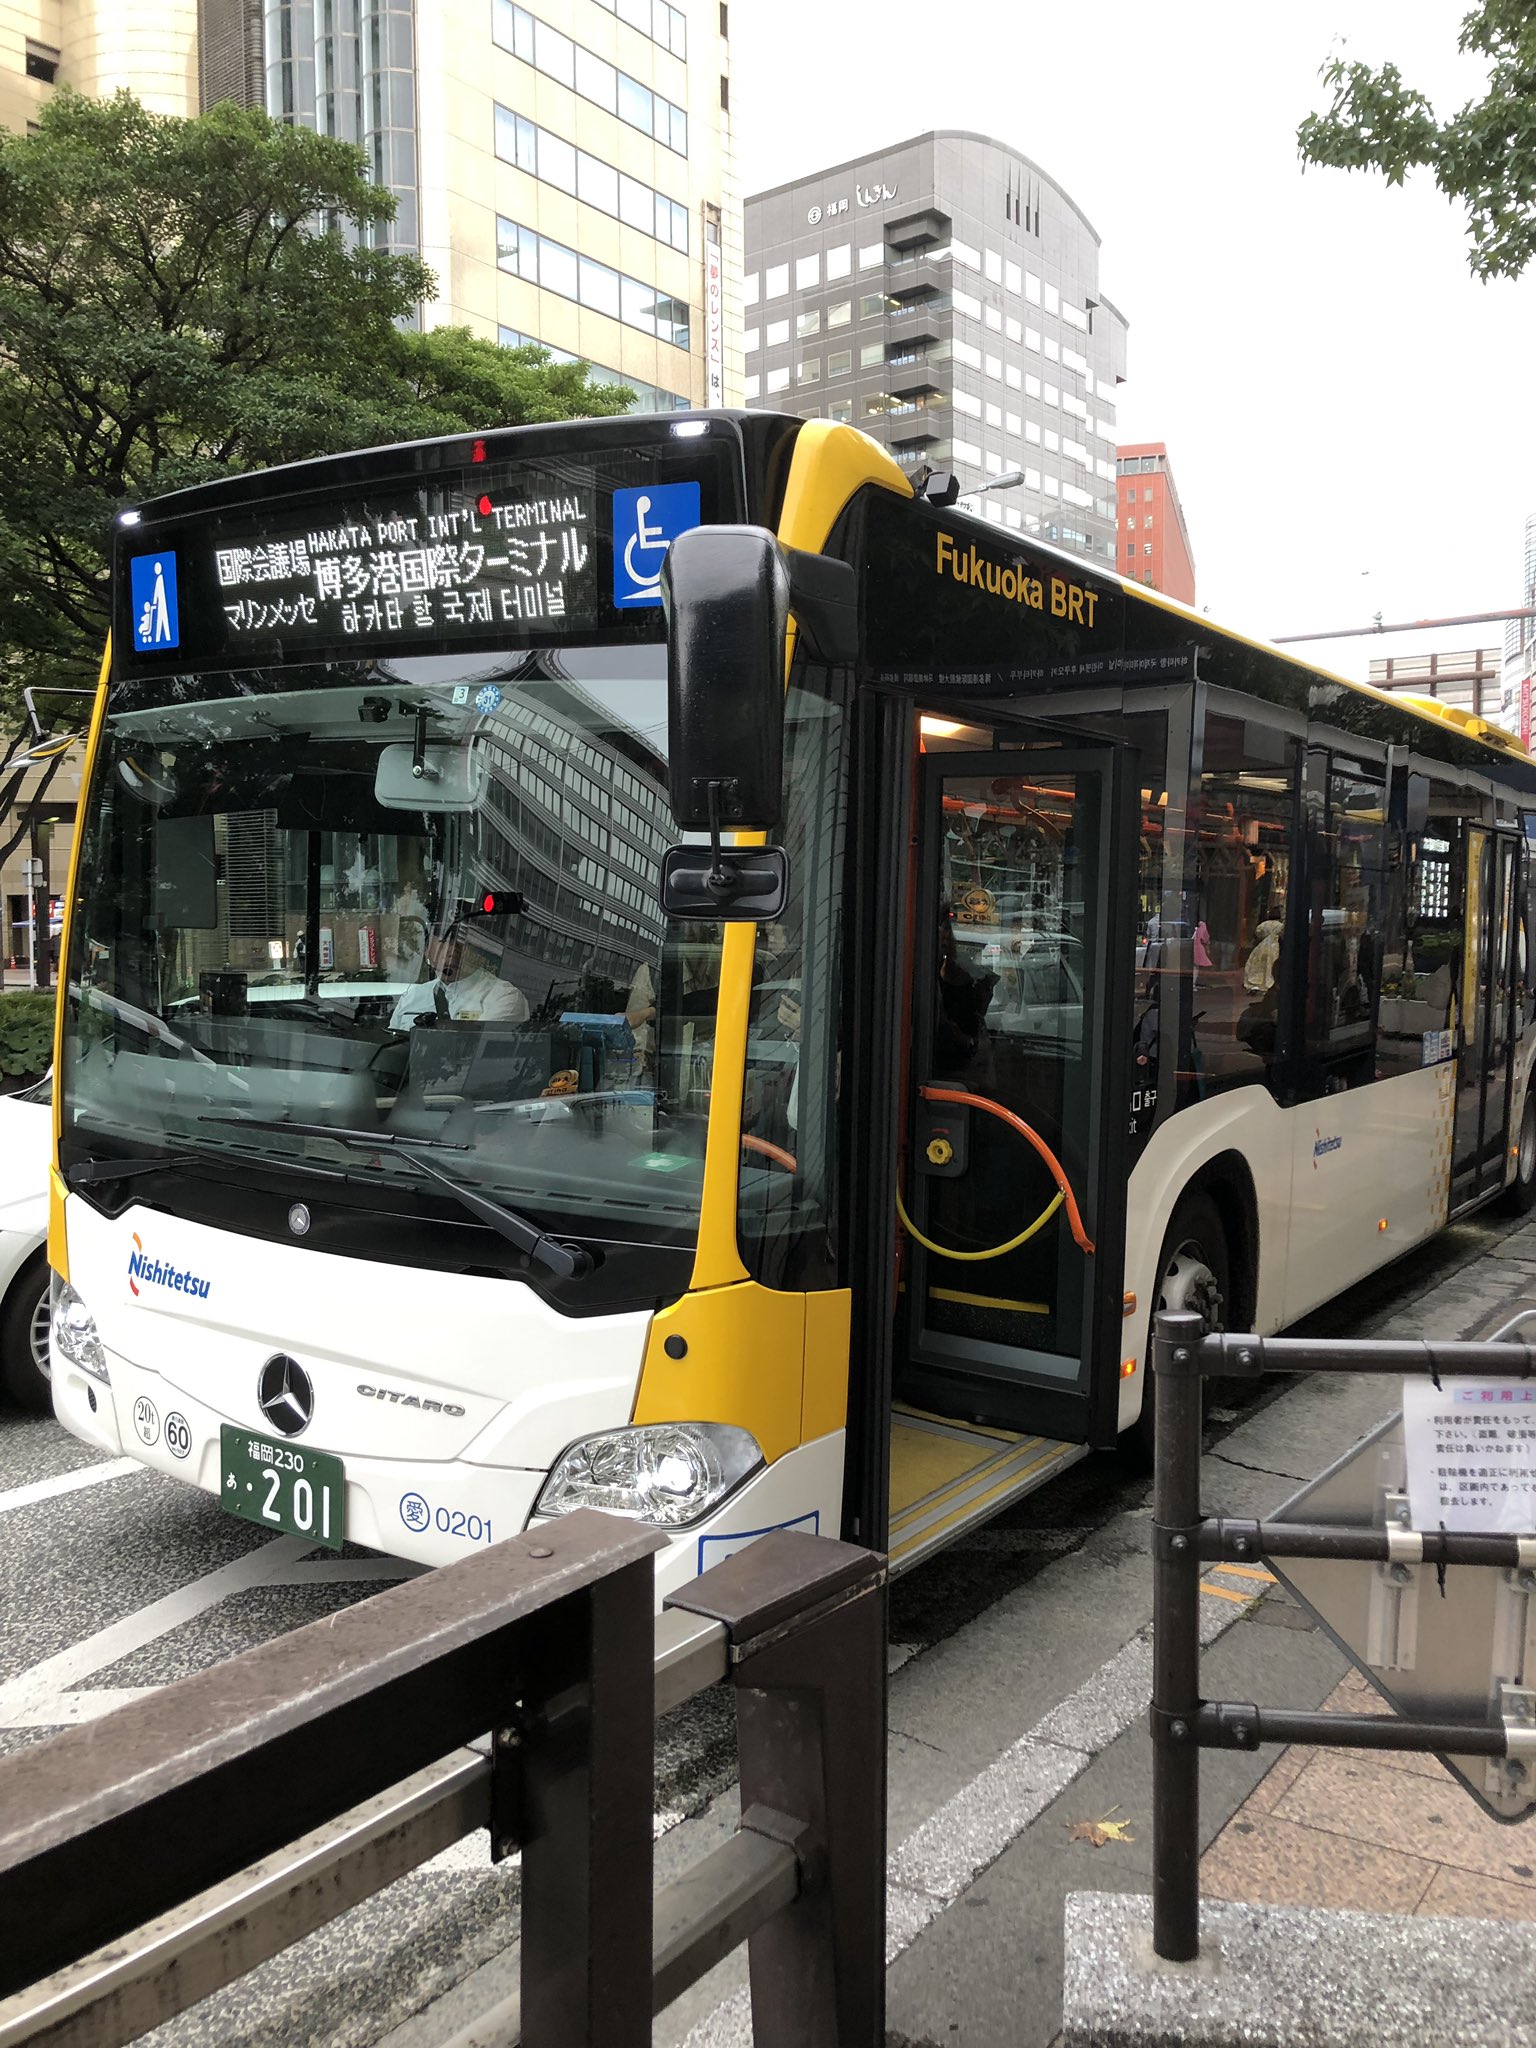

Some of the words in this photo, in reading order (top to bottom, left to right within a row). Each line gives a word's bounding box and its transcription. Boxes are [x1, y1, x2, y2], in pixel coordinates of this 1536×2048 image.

[308, 525, 373, 554] HAKATA
[377, 518, 419, 546] PORT
[428, 508, 483, 539] INT'L
[491, 495, 587, 531] TERMINAL
[215, 539, 311, 587] 国際会議場
[313, 527, 588, 601] 博多港国際ターミナル
[936, 531, 1044, 611] Fukuoka
[1051, 576, 1100, 629] BRT
[223, 593, 318, 631] マリンメッセ
[128, 1250, 211, 1299] Nishitetsu
[138, 1401, 155, 1425] 20t
[357, 1384, 466, 1417] CITARO
[168, 1421, 188, 1450] 60
[406, 1500, 424, 1525] 愛
[436, 1507, 492, 1544] 0201
